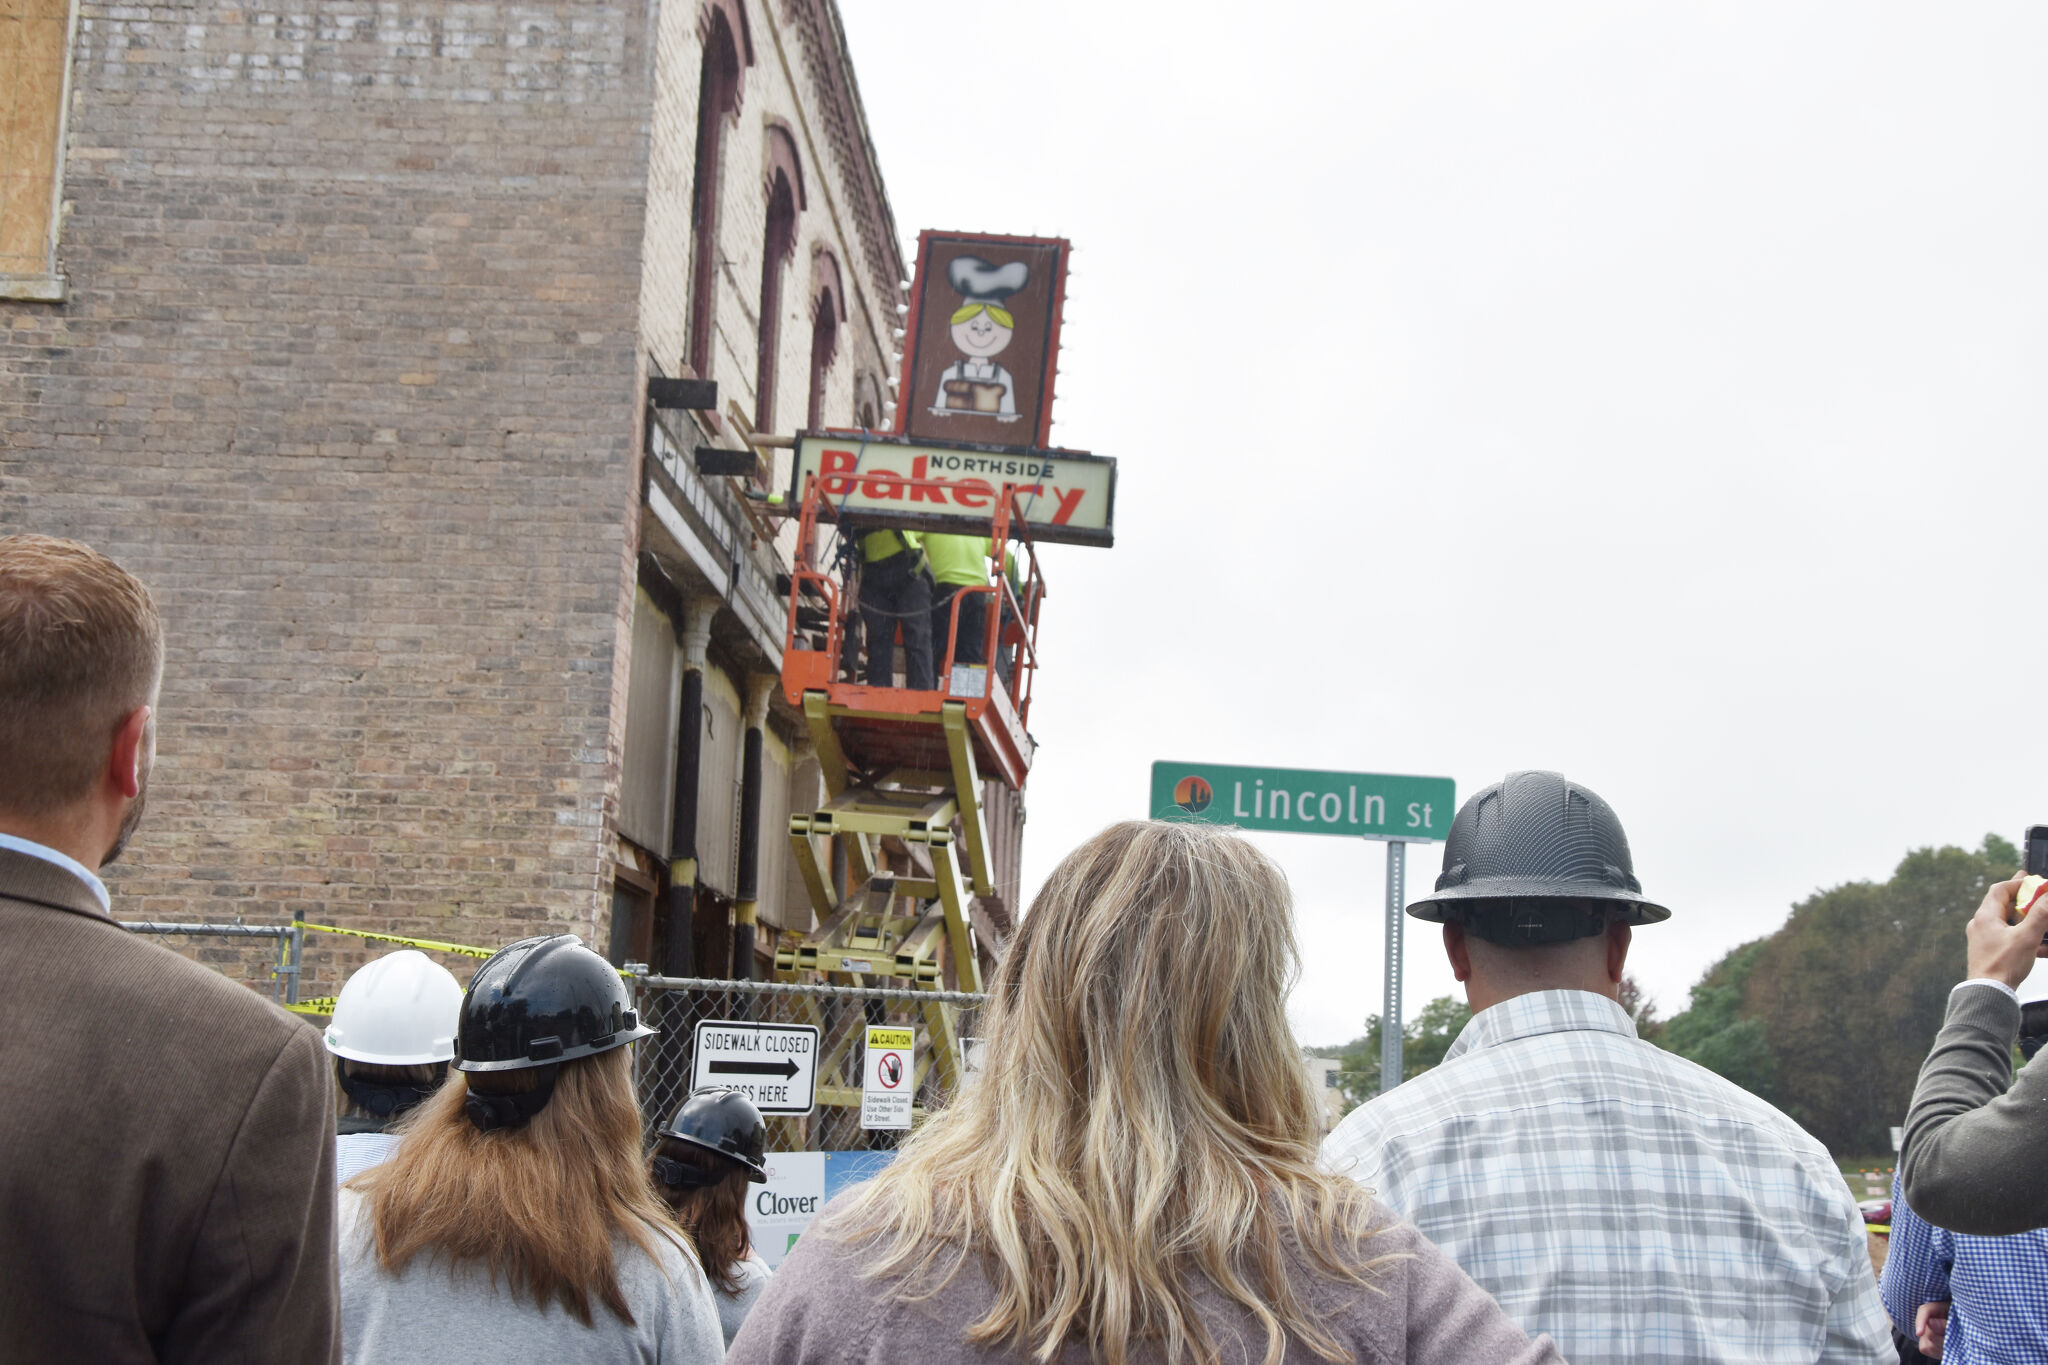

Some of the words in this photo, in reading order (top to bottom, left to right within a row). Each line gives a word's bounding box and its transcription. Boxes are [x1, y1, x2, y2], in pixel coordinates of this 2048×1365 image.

[931, 456, 1054, 478] NORTHSIDE
[1234, 779, 1385, 825] Lincoln
[1407, 803, 1433, 828] St
[704, 1033, 760, 1051] SIDEWALK
[765, 1036, 809, 1053] CLOSED
[880, 1033, 911, 1045] CAUTION
[759, 1085, 788, 1102] HERE
[757, 1191, 818, 1215] Clover
